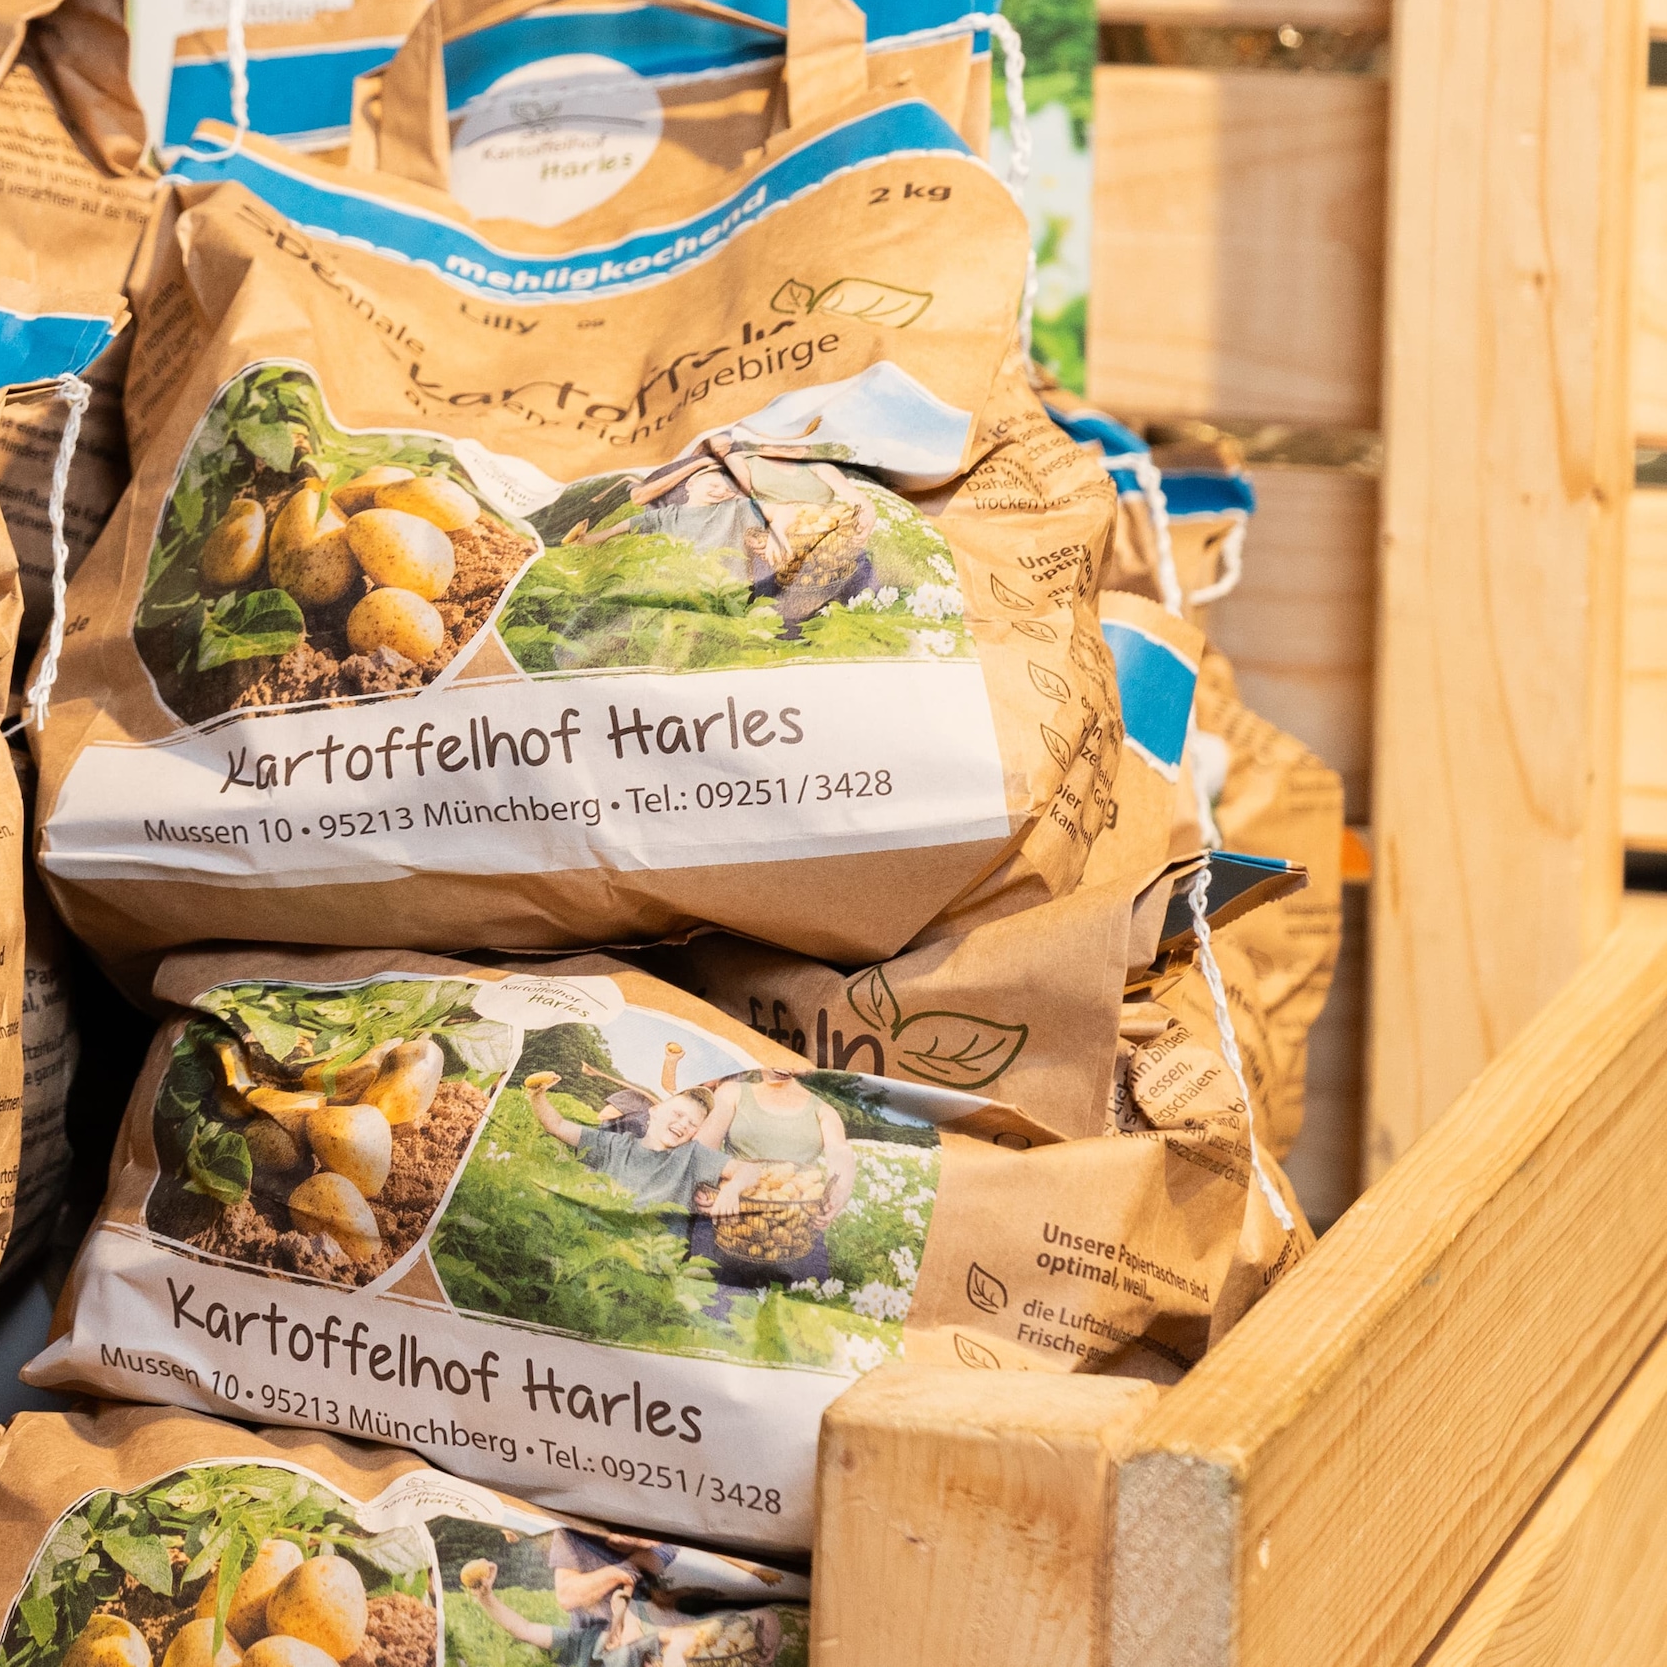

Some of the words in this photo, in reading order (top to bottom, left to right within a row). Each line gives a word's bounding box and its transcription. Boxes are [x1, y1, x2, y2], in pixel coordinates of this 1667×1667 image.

[539, 150, 635, 183] Harles
[867, 187, 890, 205] 2
[901, 179, 953, 205] kg
[445, 184, 768, 294] mehligkochend
[457, 300, 541, 336] Lilly
[218, 706, 583, 795] Kartoffelhof
[605, 694, 807, 764] Harles
[143, 816, 250, 847] Mussen
[259, 816, 293, 847] 10
[318, 806, 415, 841] 95213
[423, 793, 603, 830] Münchberg
[626, 784, 689, 818] Tel.:
[527, 993, 590, 1019] Harles
[1148, 1059, 1194, 1100] essen,
[1036, 1251, 1120, 1289] optimal,
[1043, 1221, 1117, 1260] Unsere
[1117, 1243, 1190, 1292] Papiertaschen
[1189, 1281, 1210, 1303] sind
[1023, 1299, 1055, 1321] die
[1017, 1322, 1087, 1357] Frische
[167, 1277, 500, 1404] Kartoffelhof
[522, 1358, 704, 1445] Harles
[101, 1343, 201, 1390] Mussen
[210, 1369, 240, 1402] 10
[261, 1383, 342, 1427] 95213
[348, 1401, 519, 1464] Münchberg
[538, 1437, 596, 1475] Tel.:
